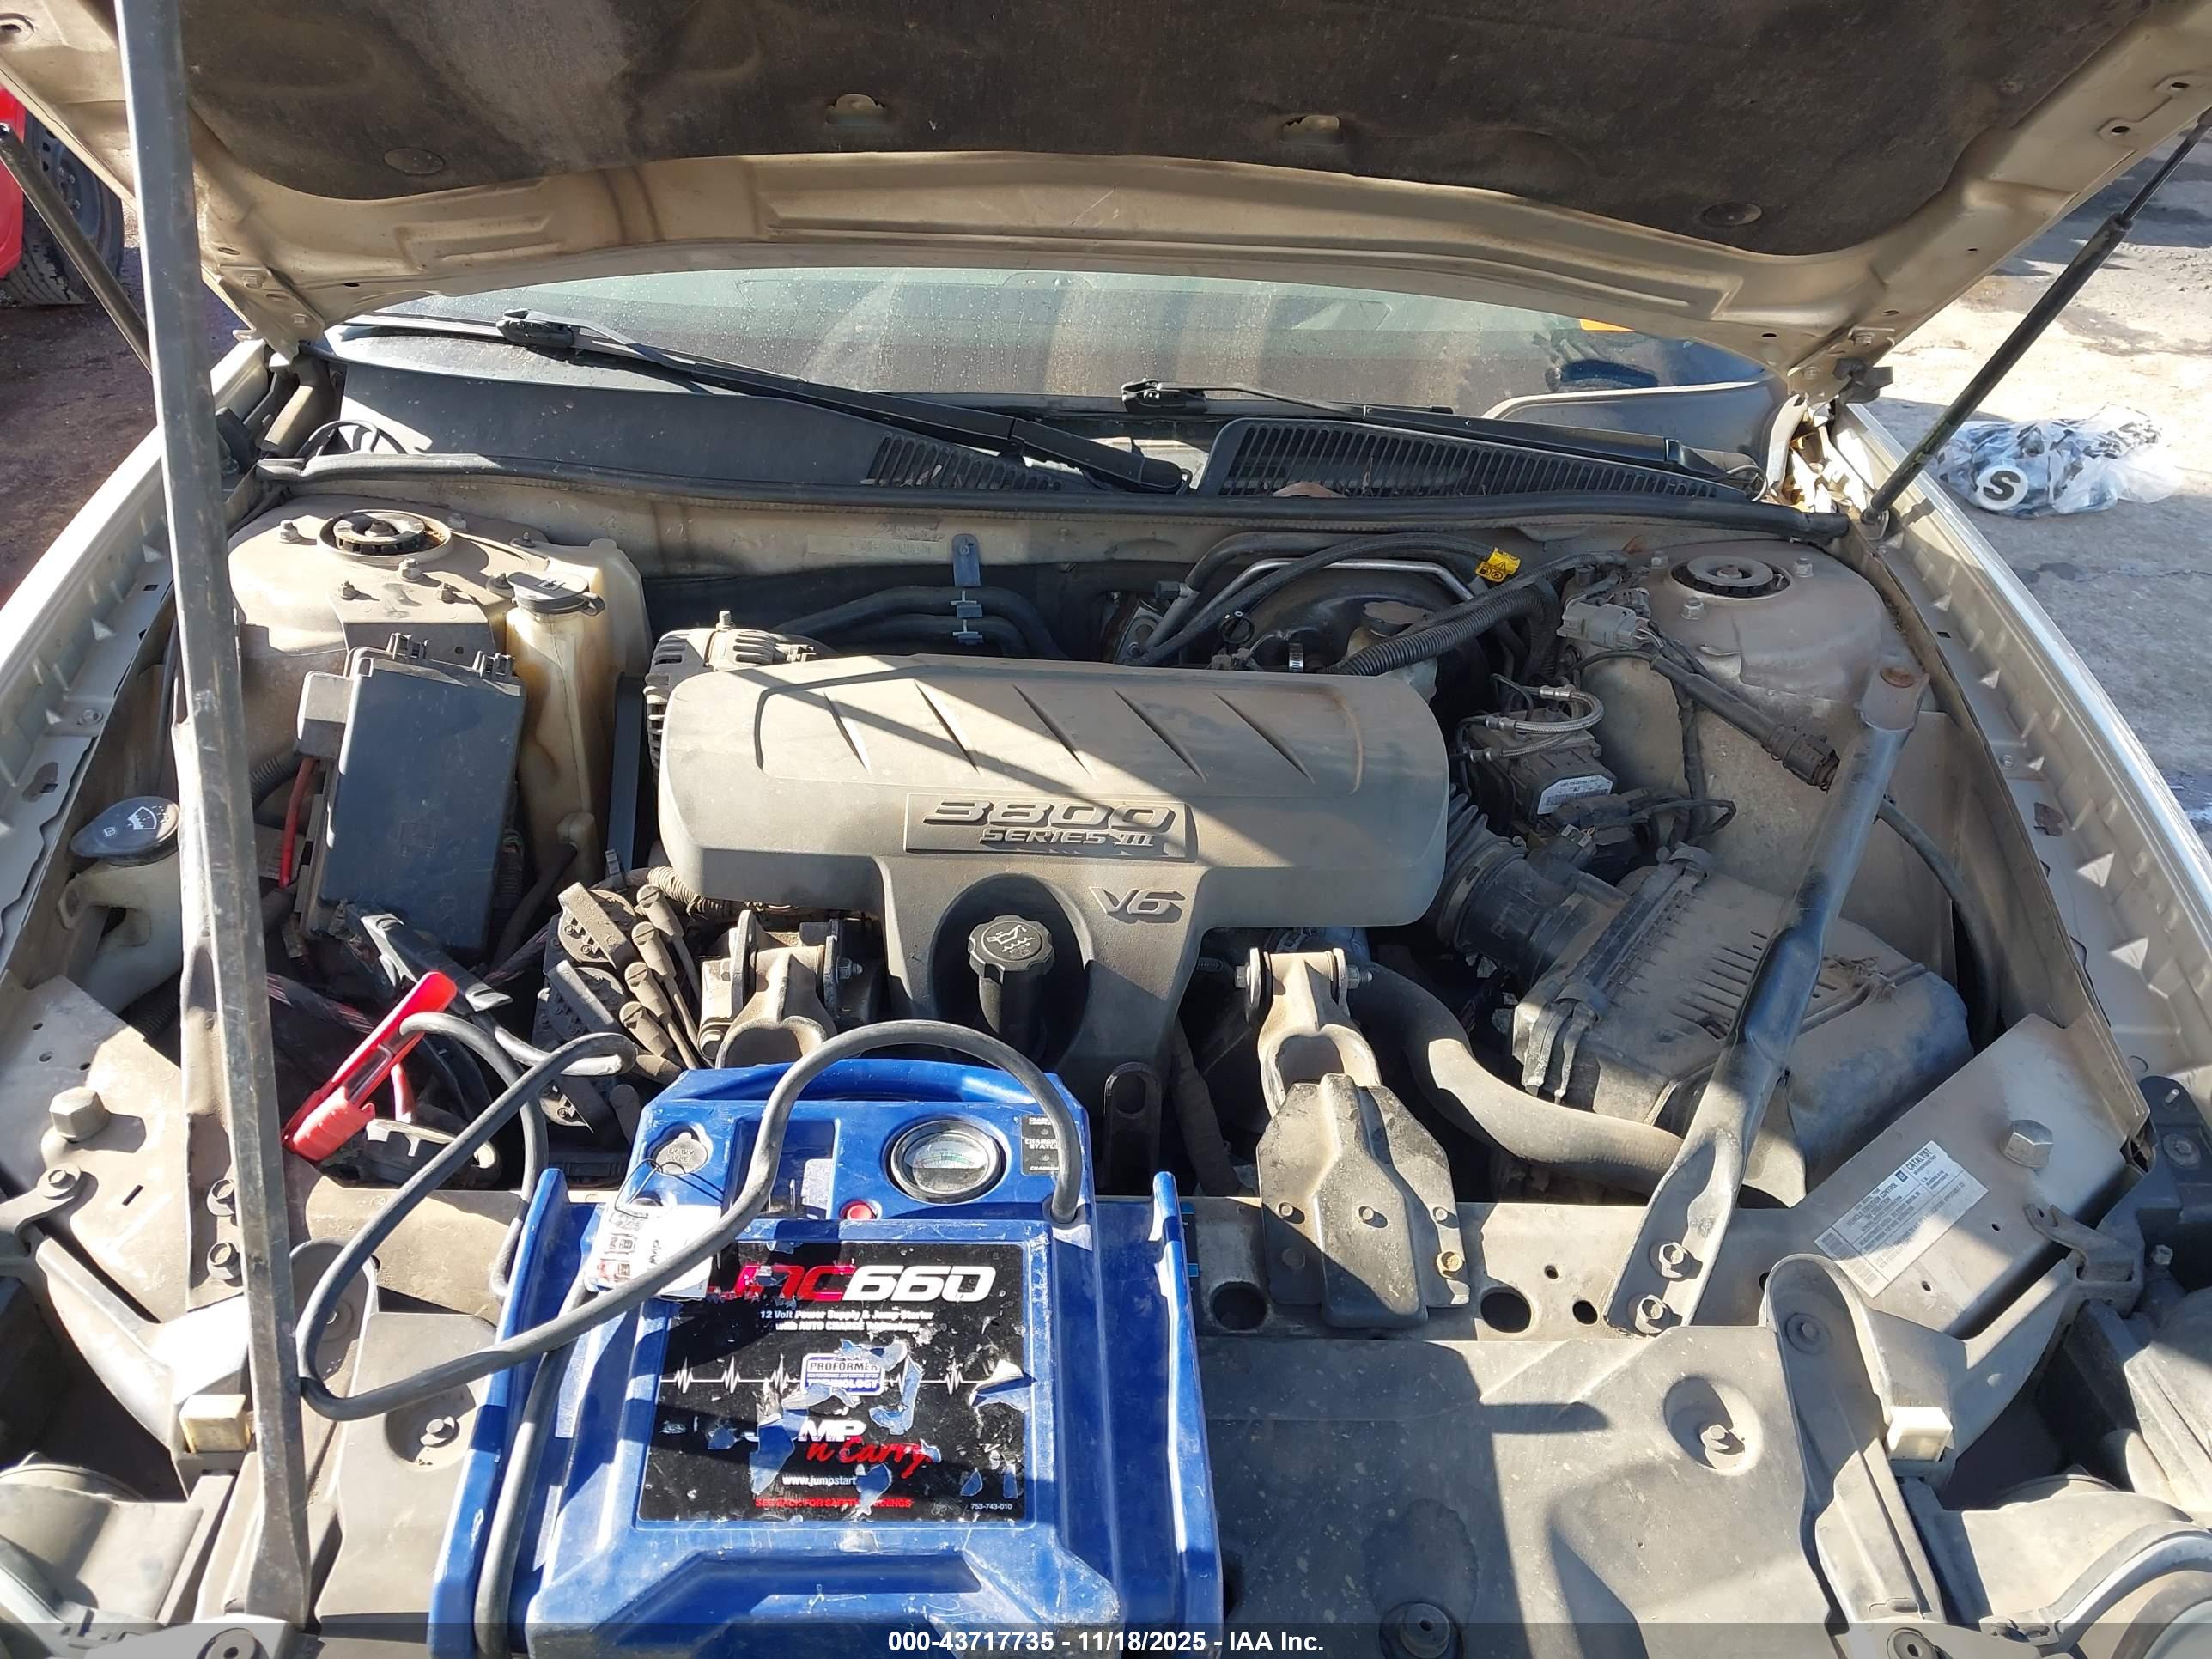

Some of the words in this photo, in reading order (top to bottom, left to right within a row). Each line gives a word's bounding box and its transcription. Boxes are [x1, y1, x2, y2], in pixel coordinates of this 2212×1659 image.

[1983, 470, 2021, 501] S
[923, 799, 1177, 831] 3800
[981, 828, 1107, 845] SERIES
[1088, 886, 1186, 917] V6
[1906, 1147, 1931, 1170] CATALYST
[760, 1310, 773, 1319] 12
[774, 1310, 793, 1319] Volt
[782, 1474, 857, 1487] www.jumpstart
